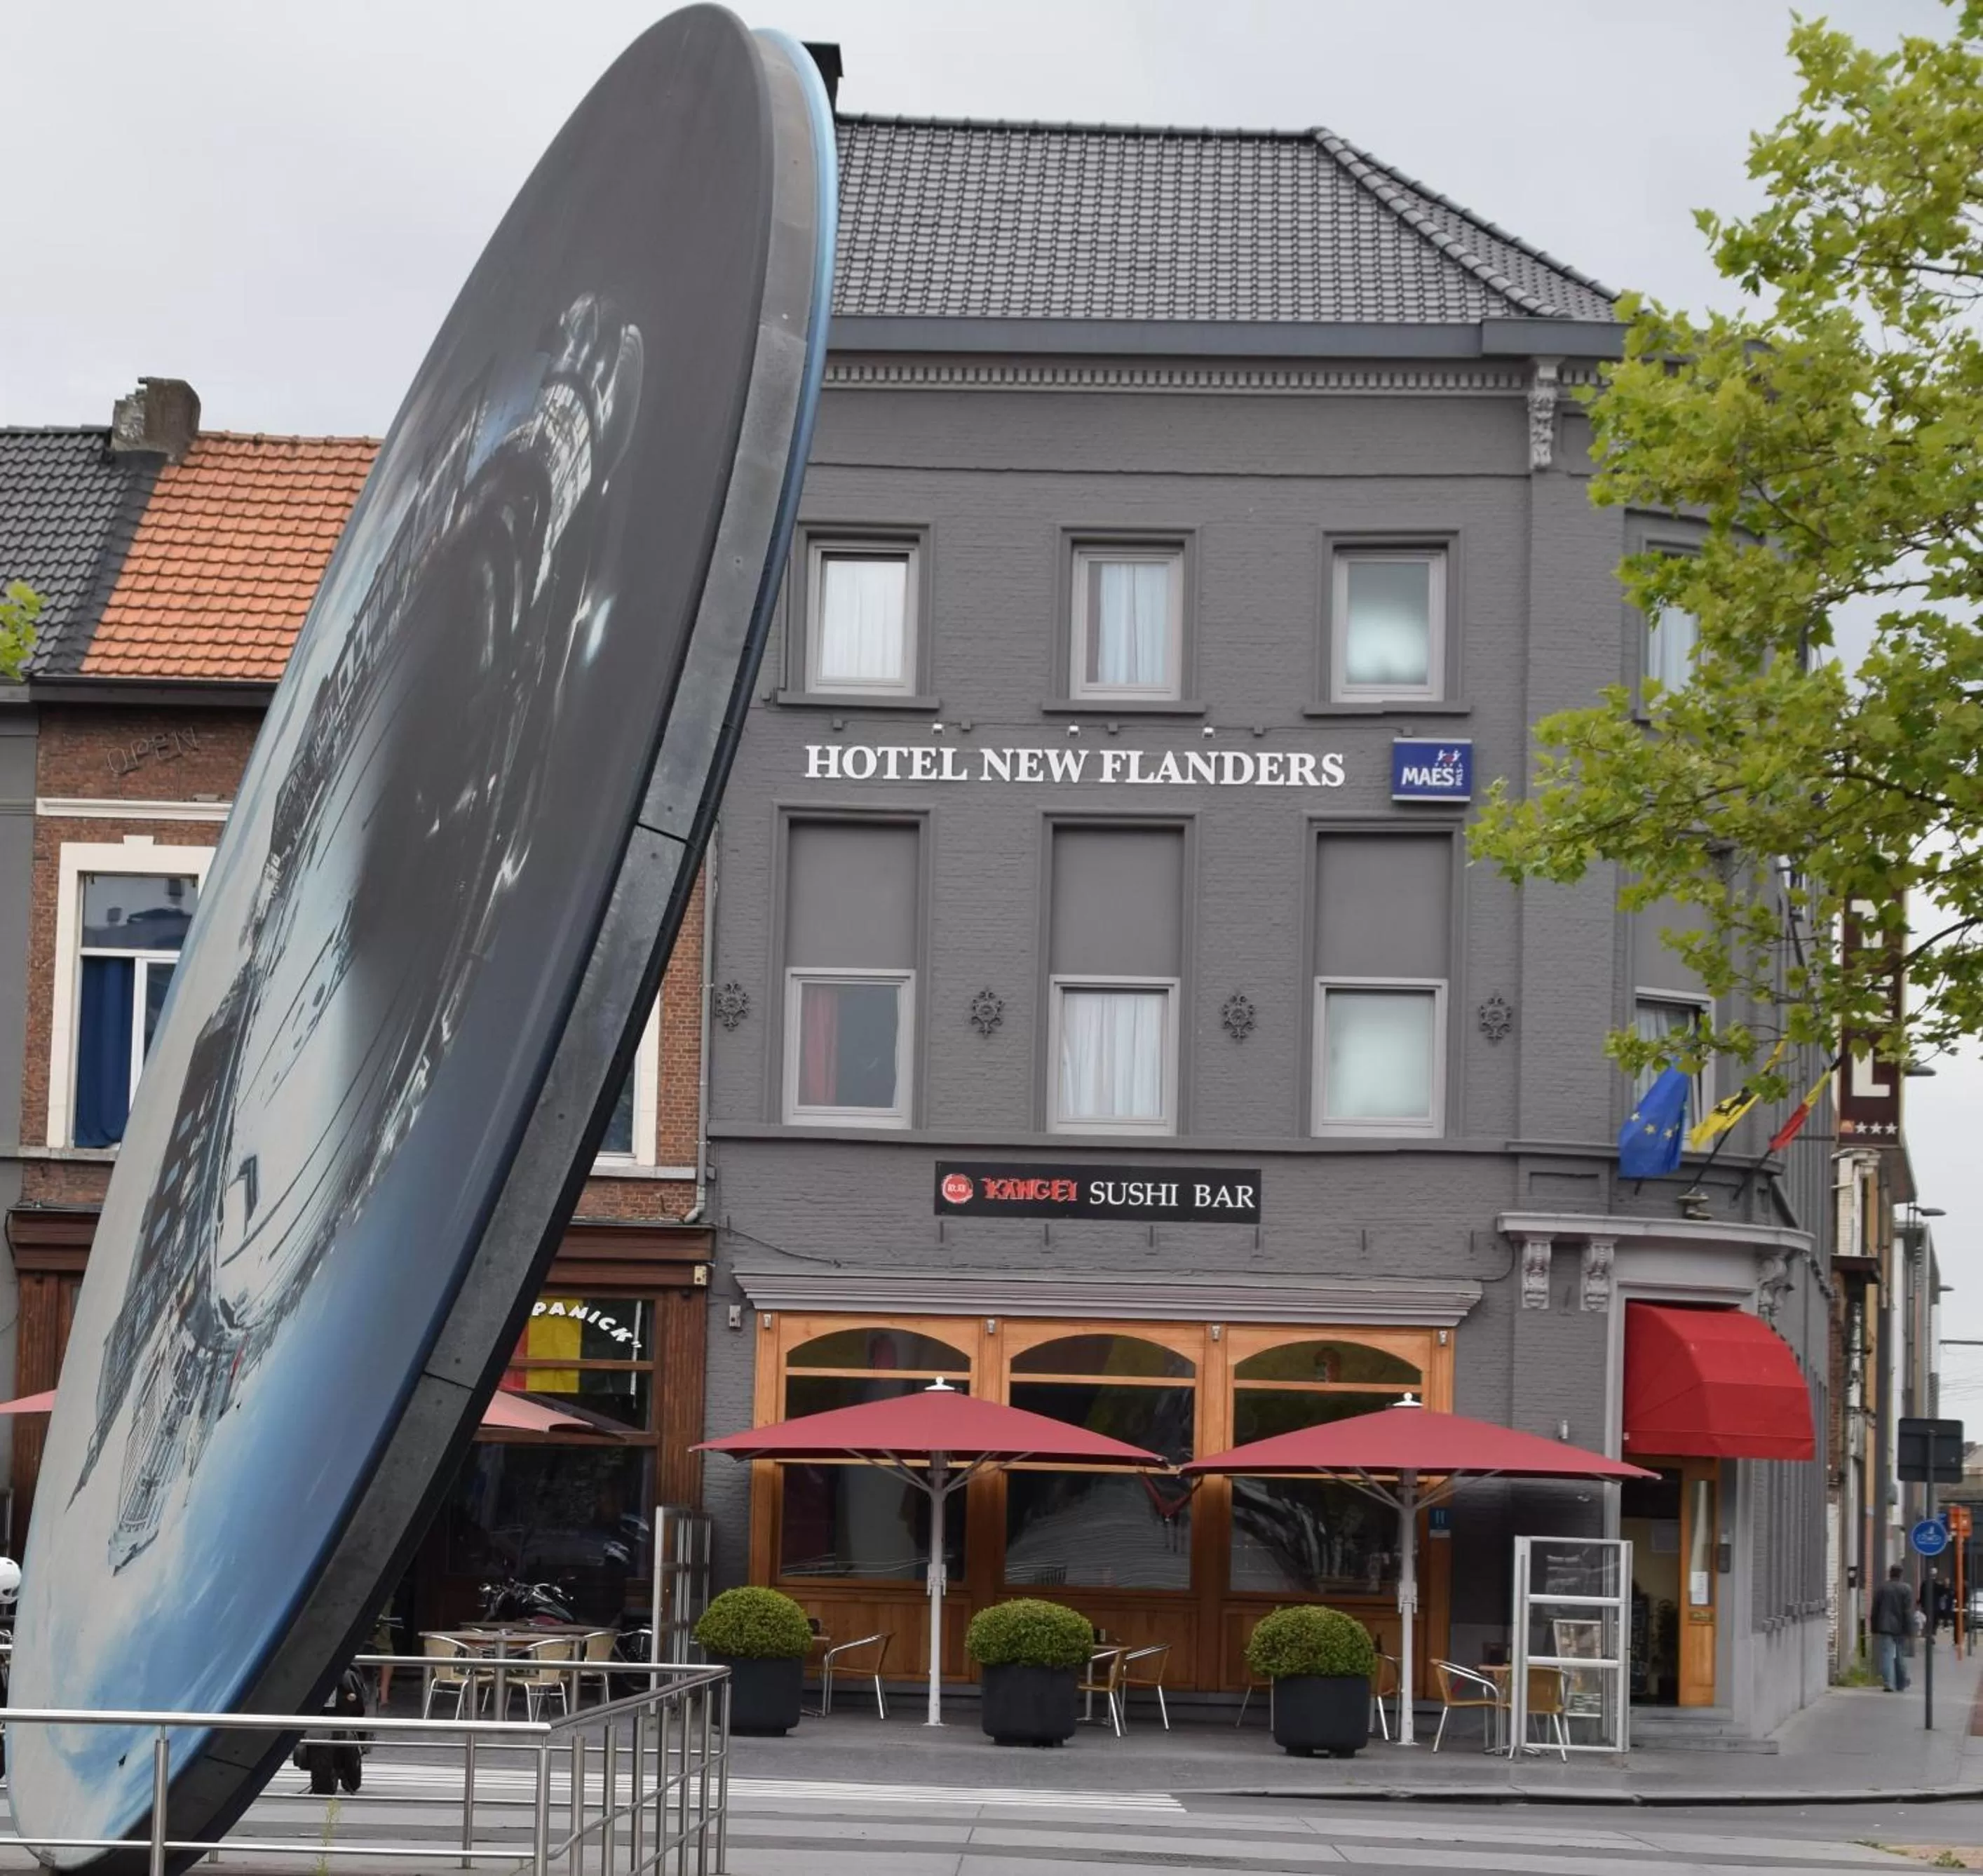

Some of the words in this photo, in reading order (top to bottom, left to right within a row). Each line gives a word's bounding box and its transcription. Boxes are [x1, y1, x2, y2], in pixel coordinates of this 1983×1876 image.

[107, 727, 199, 774] OPEN
[804, 745, 968, 781] HOTEL
[979, 748, 1090, 783] NEW
[1099, 750, 1346, 787] FLANDERS
[1401, 767, 1455, 787] MAES
[980, 1177, 1078, 1202] KANGEI
[1090, 1181, 1179, 1206] SUSHI
[1193, 1184, 1255, 1208] BAR
